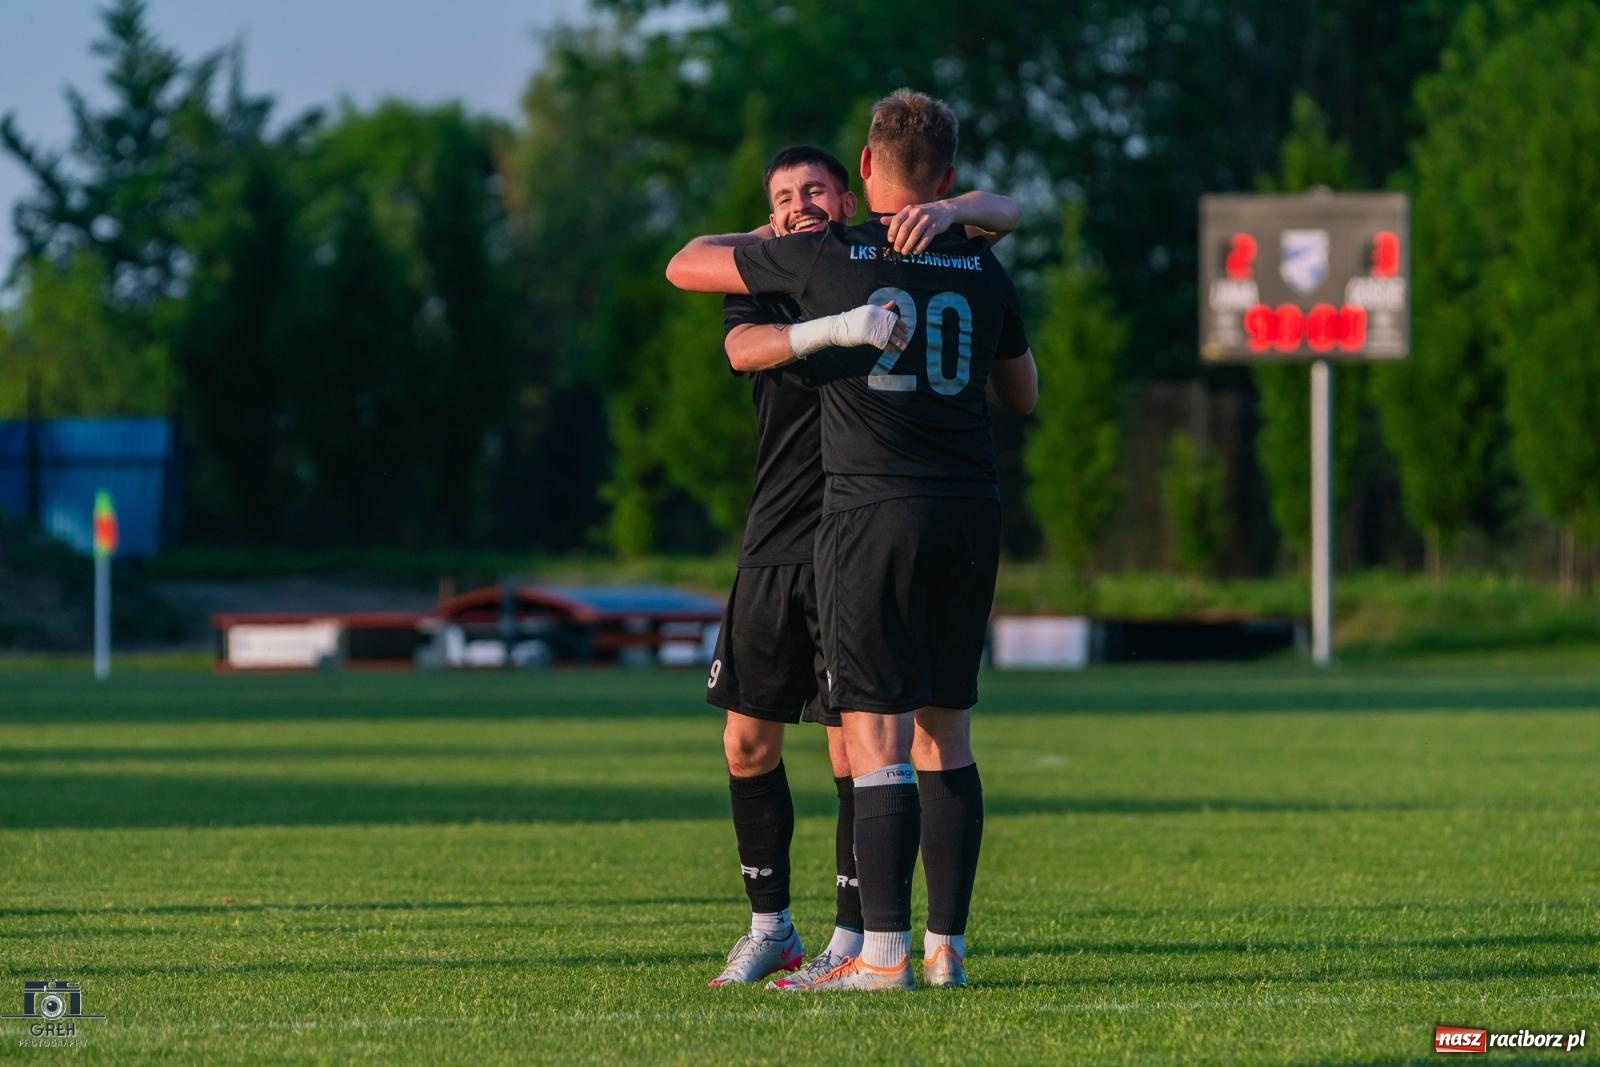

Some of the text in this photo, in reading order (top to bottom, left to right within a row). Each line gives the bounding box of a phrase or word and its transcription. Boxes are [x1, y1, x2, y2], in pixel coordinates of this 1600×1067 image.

[849, 244, 877, 260] LKS
[1226, 233, 1258, 281] 2
[866, 287, 973, 396] 20
[707, 659, 722, 689] 9
